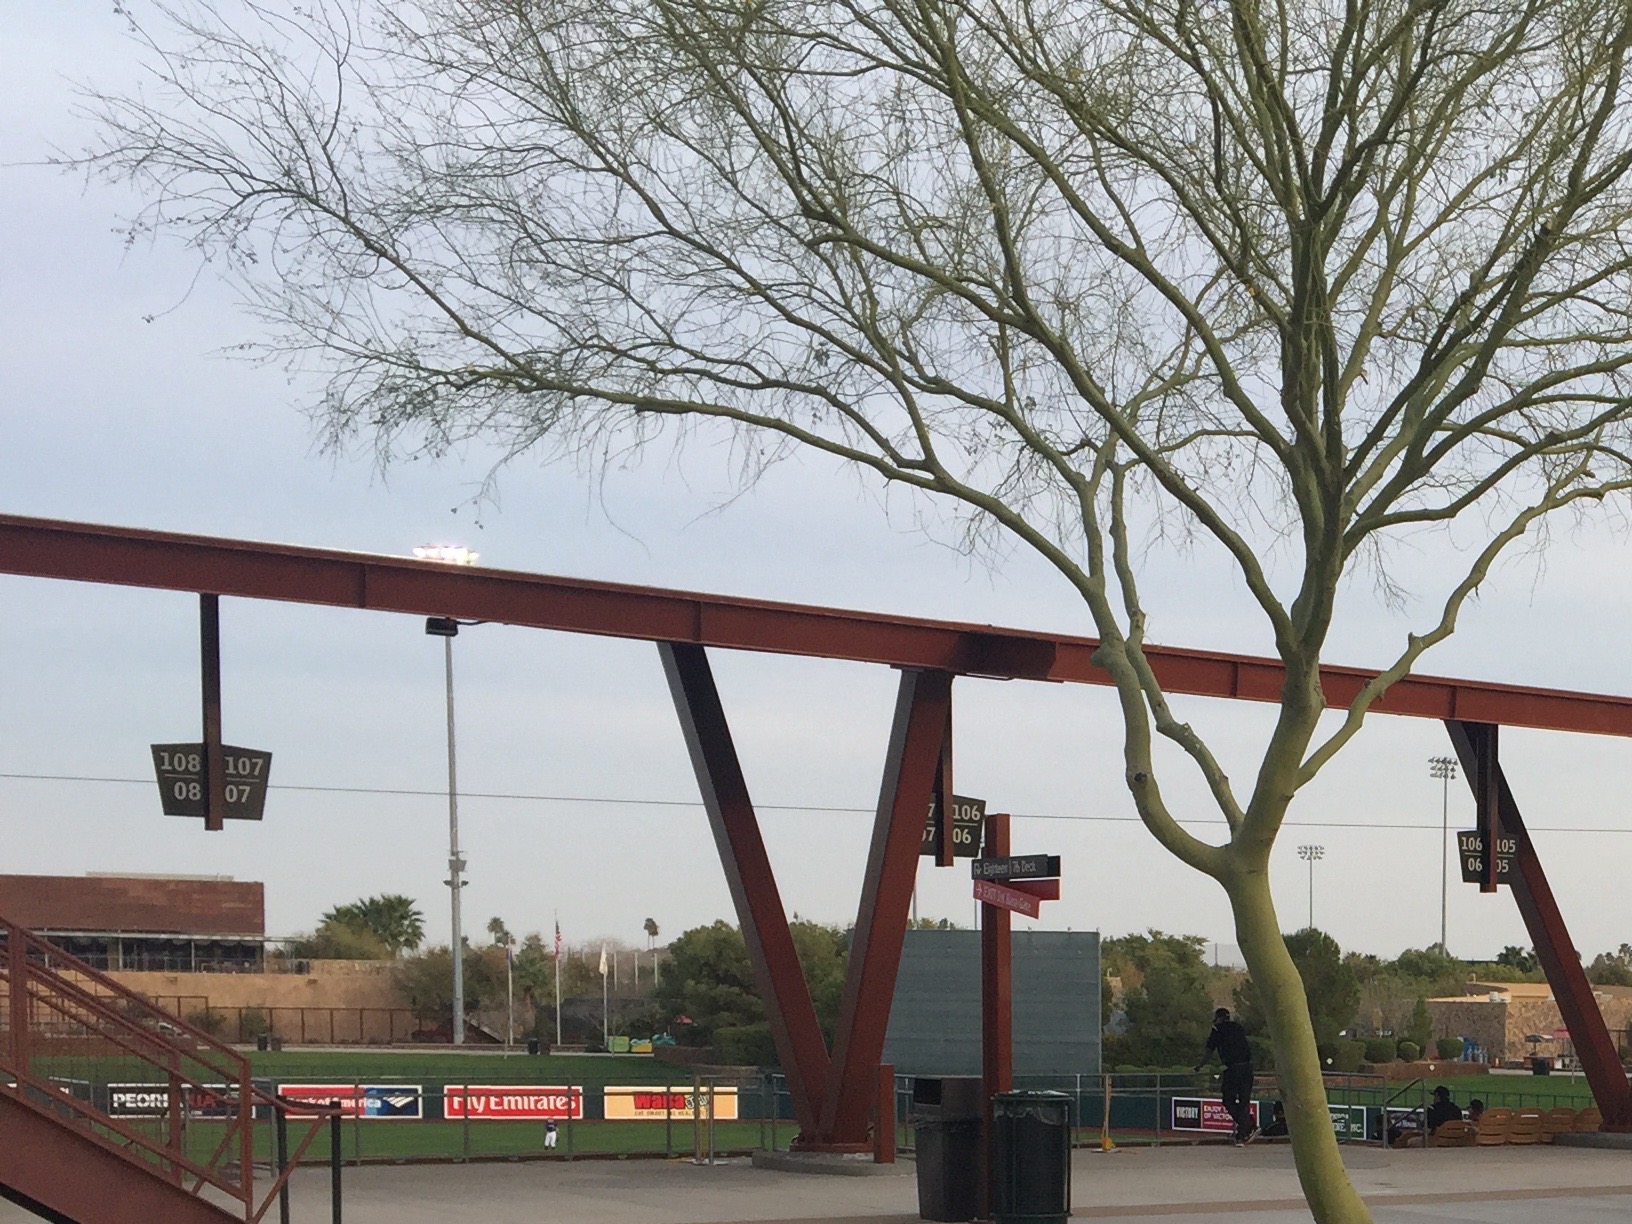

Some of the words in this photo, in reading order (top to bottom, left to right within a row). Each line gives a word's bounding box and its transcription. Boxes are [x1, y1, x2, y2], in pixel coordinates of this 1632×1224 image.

[160, 752, 201, 772] 108
[224, 756, 264, 776] 107
[174, 781, 201, 800] 08
[225, 784, 251, 803] 07
[952, 804, 981, 821] 106
[922, 826, 936, 842] 7
[952, 828, 971, 844] 06
[1461, 836, 1483, 851] 106
[1467, 857, 1483, 872] 06
[112, 1093, 184, 1109] PEORI
[489, 1094, 577, 1111] Emirates
